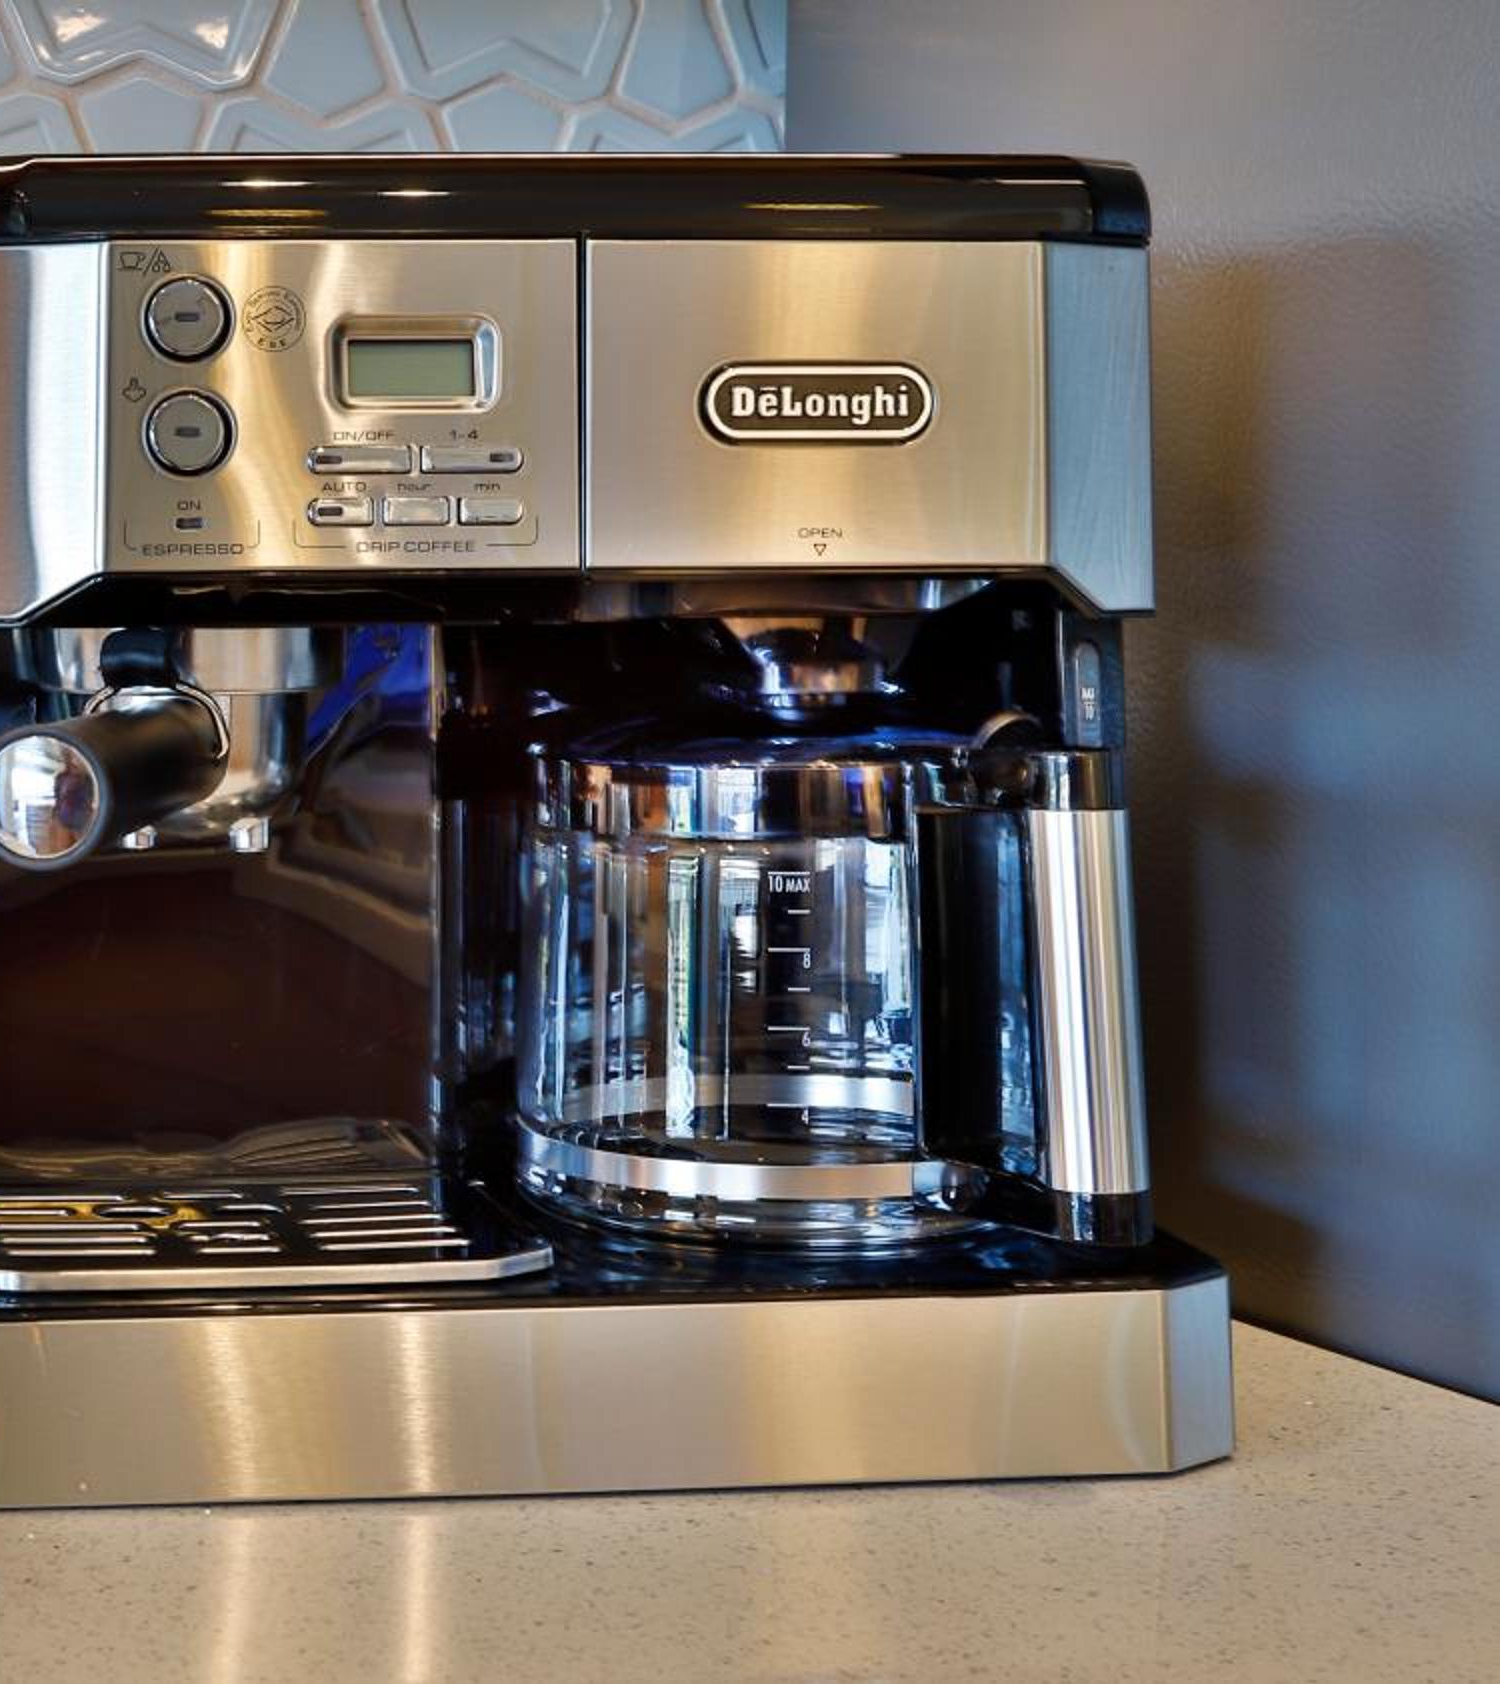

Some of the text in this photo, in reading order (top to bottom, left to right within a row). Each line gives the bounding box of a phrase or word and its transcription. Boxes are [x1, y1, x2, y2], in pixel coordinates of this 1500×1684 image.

[332, 430, 396, 441] ON/OFF
[322, 482, 367, 492] AUTO
[396, 481, 431, 492] hour
[473, 481, 501, 491] min
[176, 500, 202, 511] ON
[797, 527, 844, 538] OPEN
[141, 543, 245, 557] ESPRESSO
[356, 540, 476, 553] DRIP COFFEE
[768, 875, 811, 893] 10 MAX
[803, 952, 811, 969] 8
[802, 1031, 810, 1047] 6
[801, 1108, 809, 1125] 4
